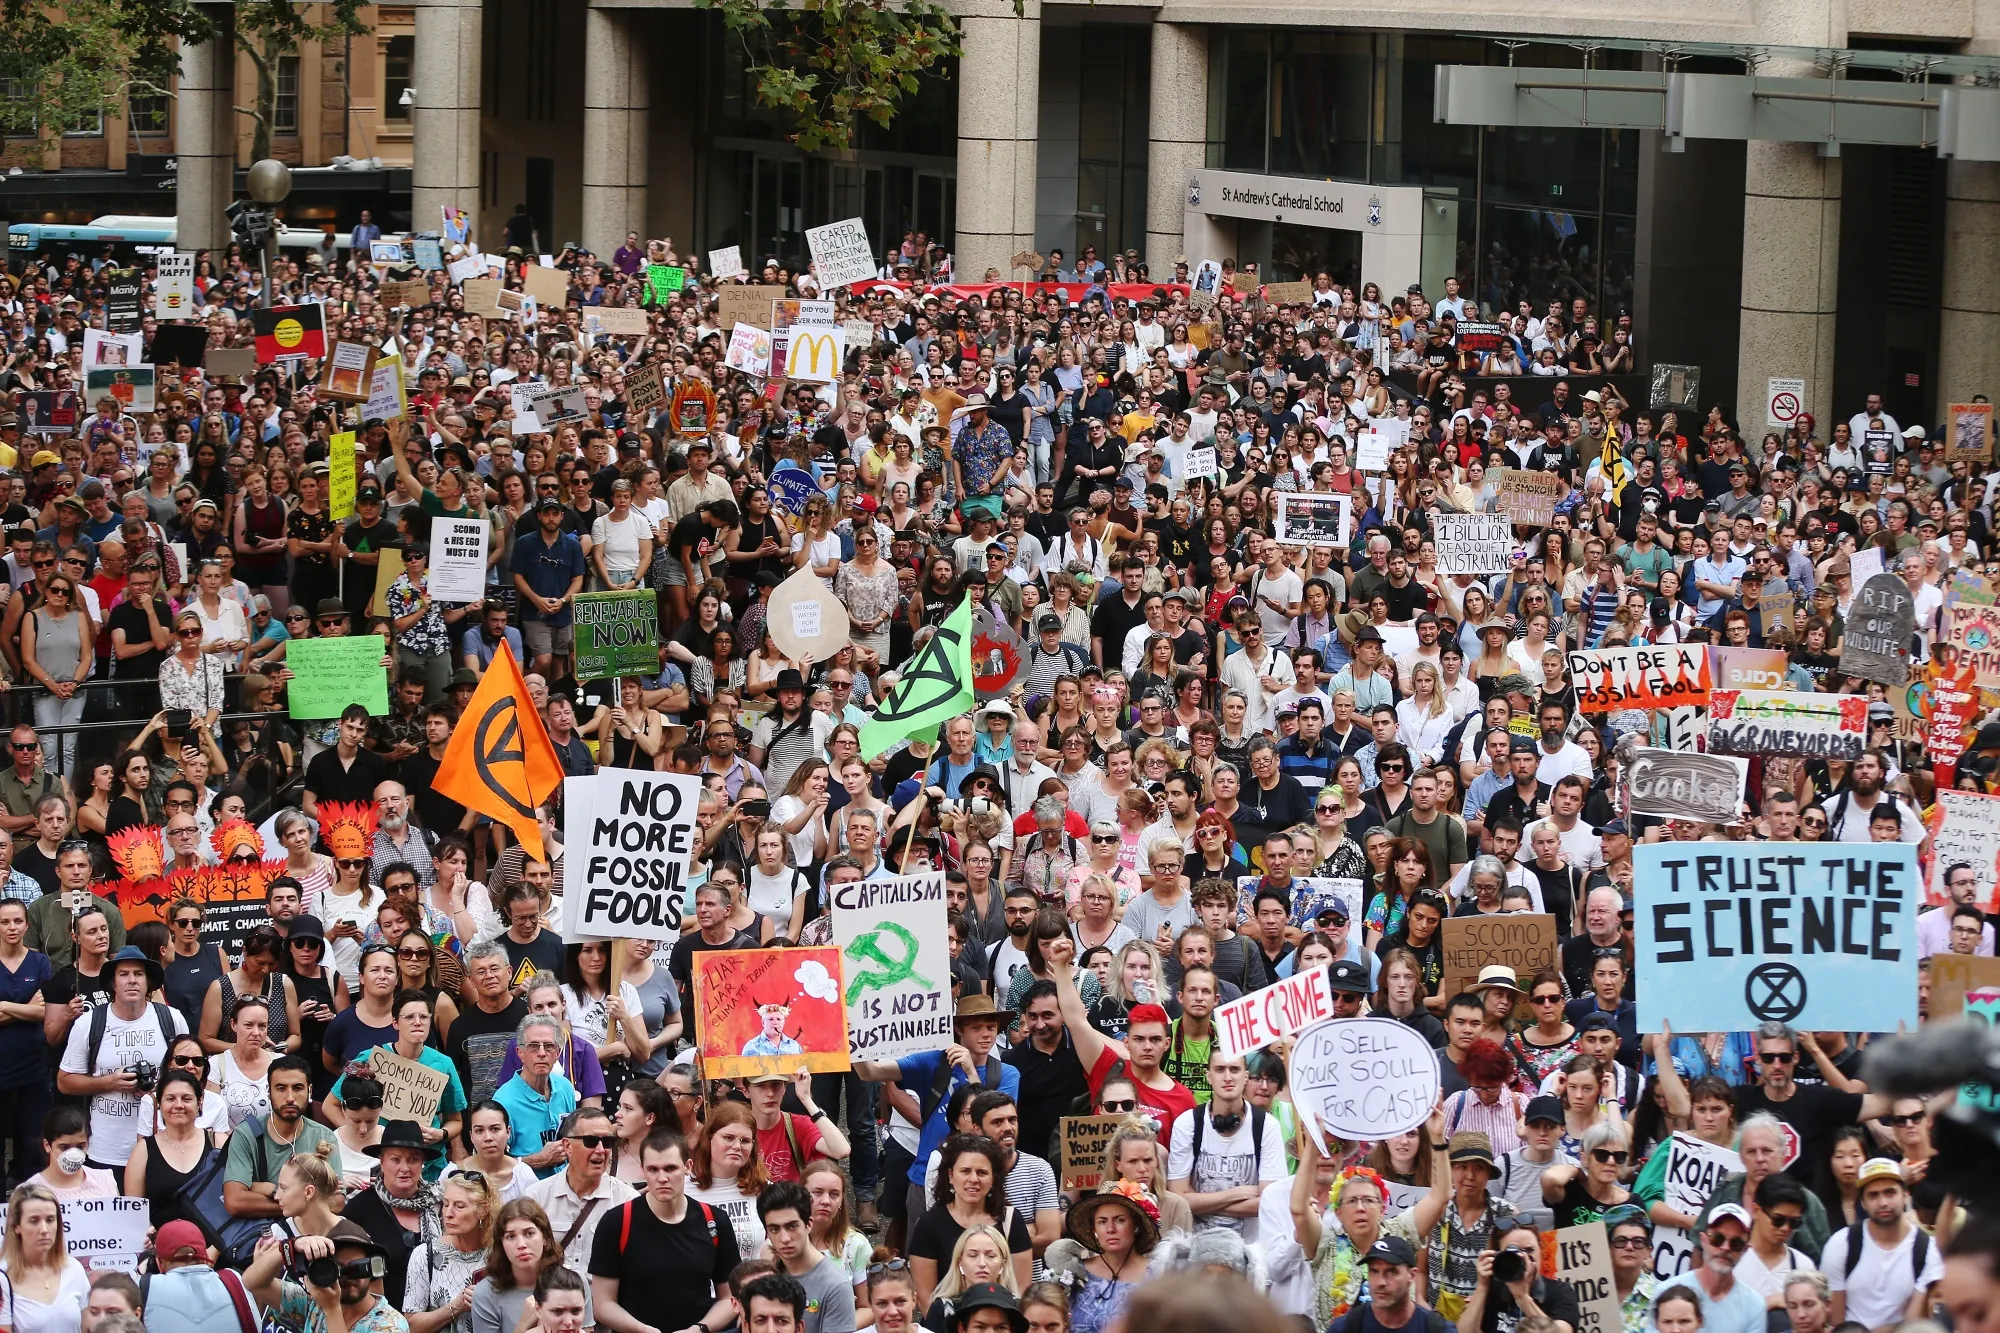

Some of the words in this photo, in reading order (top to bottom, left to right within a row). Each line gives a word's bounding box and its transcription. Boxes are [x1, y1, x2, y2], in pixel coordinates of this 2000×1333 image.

[1222, 187, 1232, 201] St
[1233, 188, 1270, 206] Andrew's
[1272, 192, 1312, 211] Cathedral
[1314, 196, 1344, 213] School
[812, 224, 855, 243] SCARED
[814, 231, 867, 254] COALITION
[160, 257, 180, 266] NOT
[183, 258, 190, 266] A
[817, 243, 867, 264] OPPOSING
[820, 255, 873, 272] MAINSTREAM
[160, 268, 191, 277] HAPPY
[821, 267, 866, 285] OPINION
[110, 285, 139, 296] Manly
[727, 290, 771, 302] DENIAL
[625, 370, 654, 389] ABOLISH
[631, 380, 659, 400] FOSSIL
[634, 390, 661, 410] FUELS
[1186, 452, 1196, 461] OK
[1201, 465, 1212, 473] GO!
[771, 473, 808, 494] CLIMATE
[454, 524, 481, 535] SCOMO
[1436, 515, 1455, 524] THIS
[1458, 515, 1466, 524] IS
[1469, 515, 1484, 524] FOR
[1487, 514, 1506, 523] THE
[444, 537, 450, 545] &
[451, 536, 464, 546] HIS
[465, 537, 480, 547] EGO
[1439, 526, 1450, 541] 1
[1454, 525, 1509, 541] BILLION
[445, 547, 467, 558] MUST
[468, 550, 479, 559] GO
[1437, 542, 1471, 554] DEAD
[1474, 542, 1507, 554] QUIET
[1864, 588, 1906, 613] RIP
[574, 599, 655, 625] RENEWABLES
[594, 618, 659, 649] NOW!
[1867, 619, 1893, 636] OUR
[1844, 631, 1900, 658] WILDLIFE
[578, 656, 591, 668] NO
[593, 655, 608, 667] OIL
[615, 653, 628, 663] NO
[629, 651, 657, 661] COAL
[1570, 654, 1628, 675] DON'T
[1637, 651, 1666, 671] BE
[1677, 650, 1695, 670] A
[1575, 682, 1641, 706] FOSSIL
[1649, 678, 1705, 697] FOOL
[1522, 727, 1534, 735] FOR
[620, 780, 682, 822] NO
[1941, 791, 1959, 805] GO
[592, 817, 691, 854] MORE
[1932, 839, 1982, 854] CAPTAIN
[587, 856, 686, 893] FOSSIL
[1661, 855, 1806, 896] TRUST
[1820, 857, 1905, 899] THE
[834, 878, 942, 910] CAPITALISM
[240, 904, 260, 912] FOREST
[584, 887, 684, 931] FOOLS
[1464, 923, 1541, 947] SCOMO
[1652, 896, 1902, 964] SCIENCE
[1447, 948, 1499, 971] NEEDS
[1501, 948, 1523, 968] TO
[1524, 941, 1554, 972] GO!
[705, 956, 745, 991] LIAR
[707, 982, 736, 1014] LIAR
[711, 984, 748, 1028] CLIMATE
[746, 954, 778, 984] DENIER
[863, 997, 882, 1019] IS
[892, 991, 941, 1015] NOT
[1221, 999, 1261, 1055] THE
[1264, 970, 1327, 1038] CRIME
[111, 1029, 156, 1048] TIME
[1312, 1033, 1334, 1059] I'D
[1339, 1028, 1398, 1054] SELL
[117, 1050, 144, 1071] TO
[373, 1051, 413, 1087] SCOMO,
[415, 1072, 441, 1094] HOW
[1295, 1061, 1340, 1091] YOUR
[1349, 1057, 1429, 1082] SOUL
[409, 1092, 438, 1123] YOU?
[1323, 1094, 1358, 1118] FOR
[1362, 1083, 1430, 1124] CASH
[1066, 1120, 1100, 1139] HOW
[1068, 1140, 1090, 1156] YOU
[1068, 1156, 1096, 1168] WHILE
[93, 1260, 106, 1268] THIS
[1559, 1239, 1592, 1271] It's
